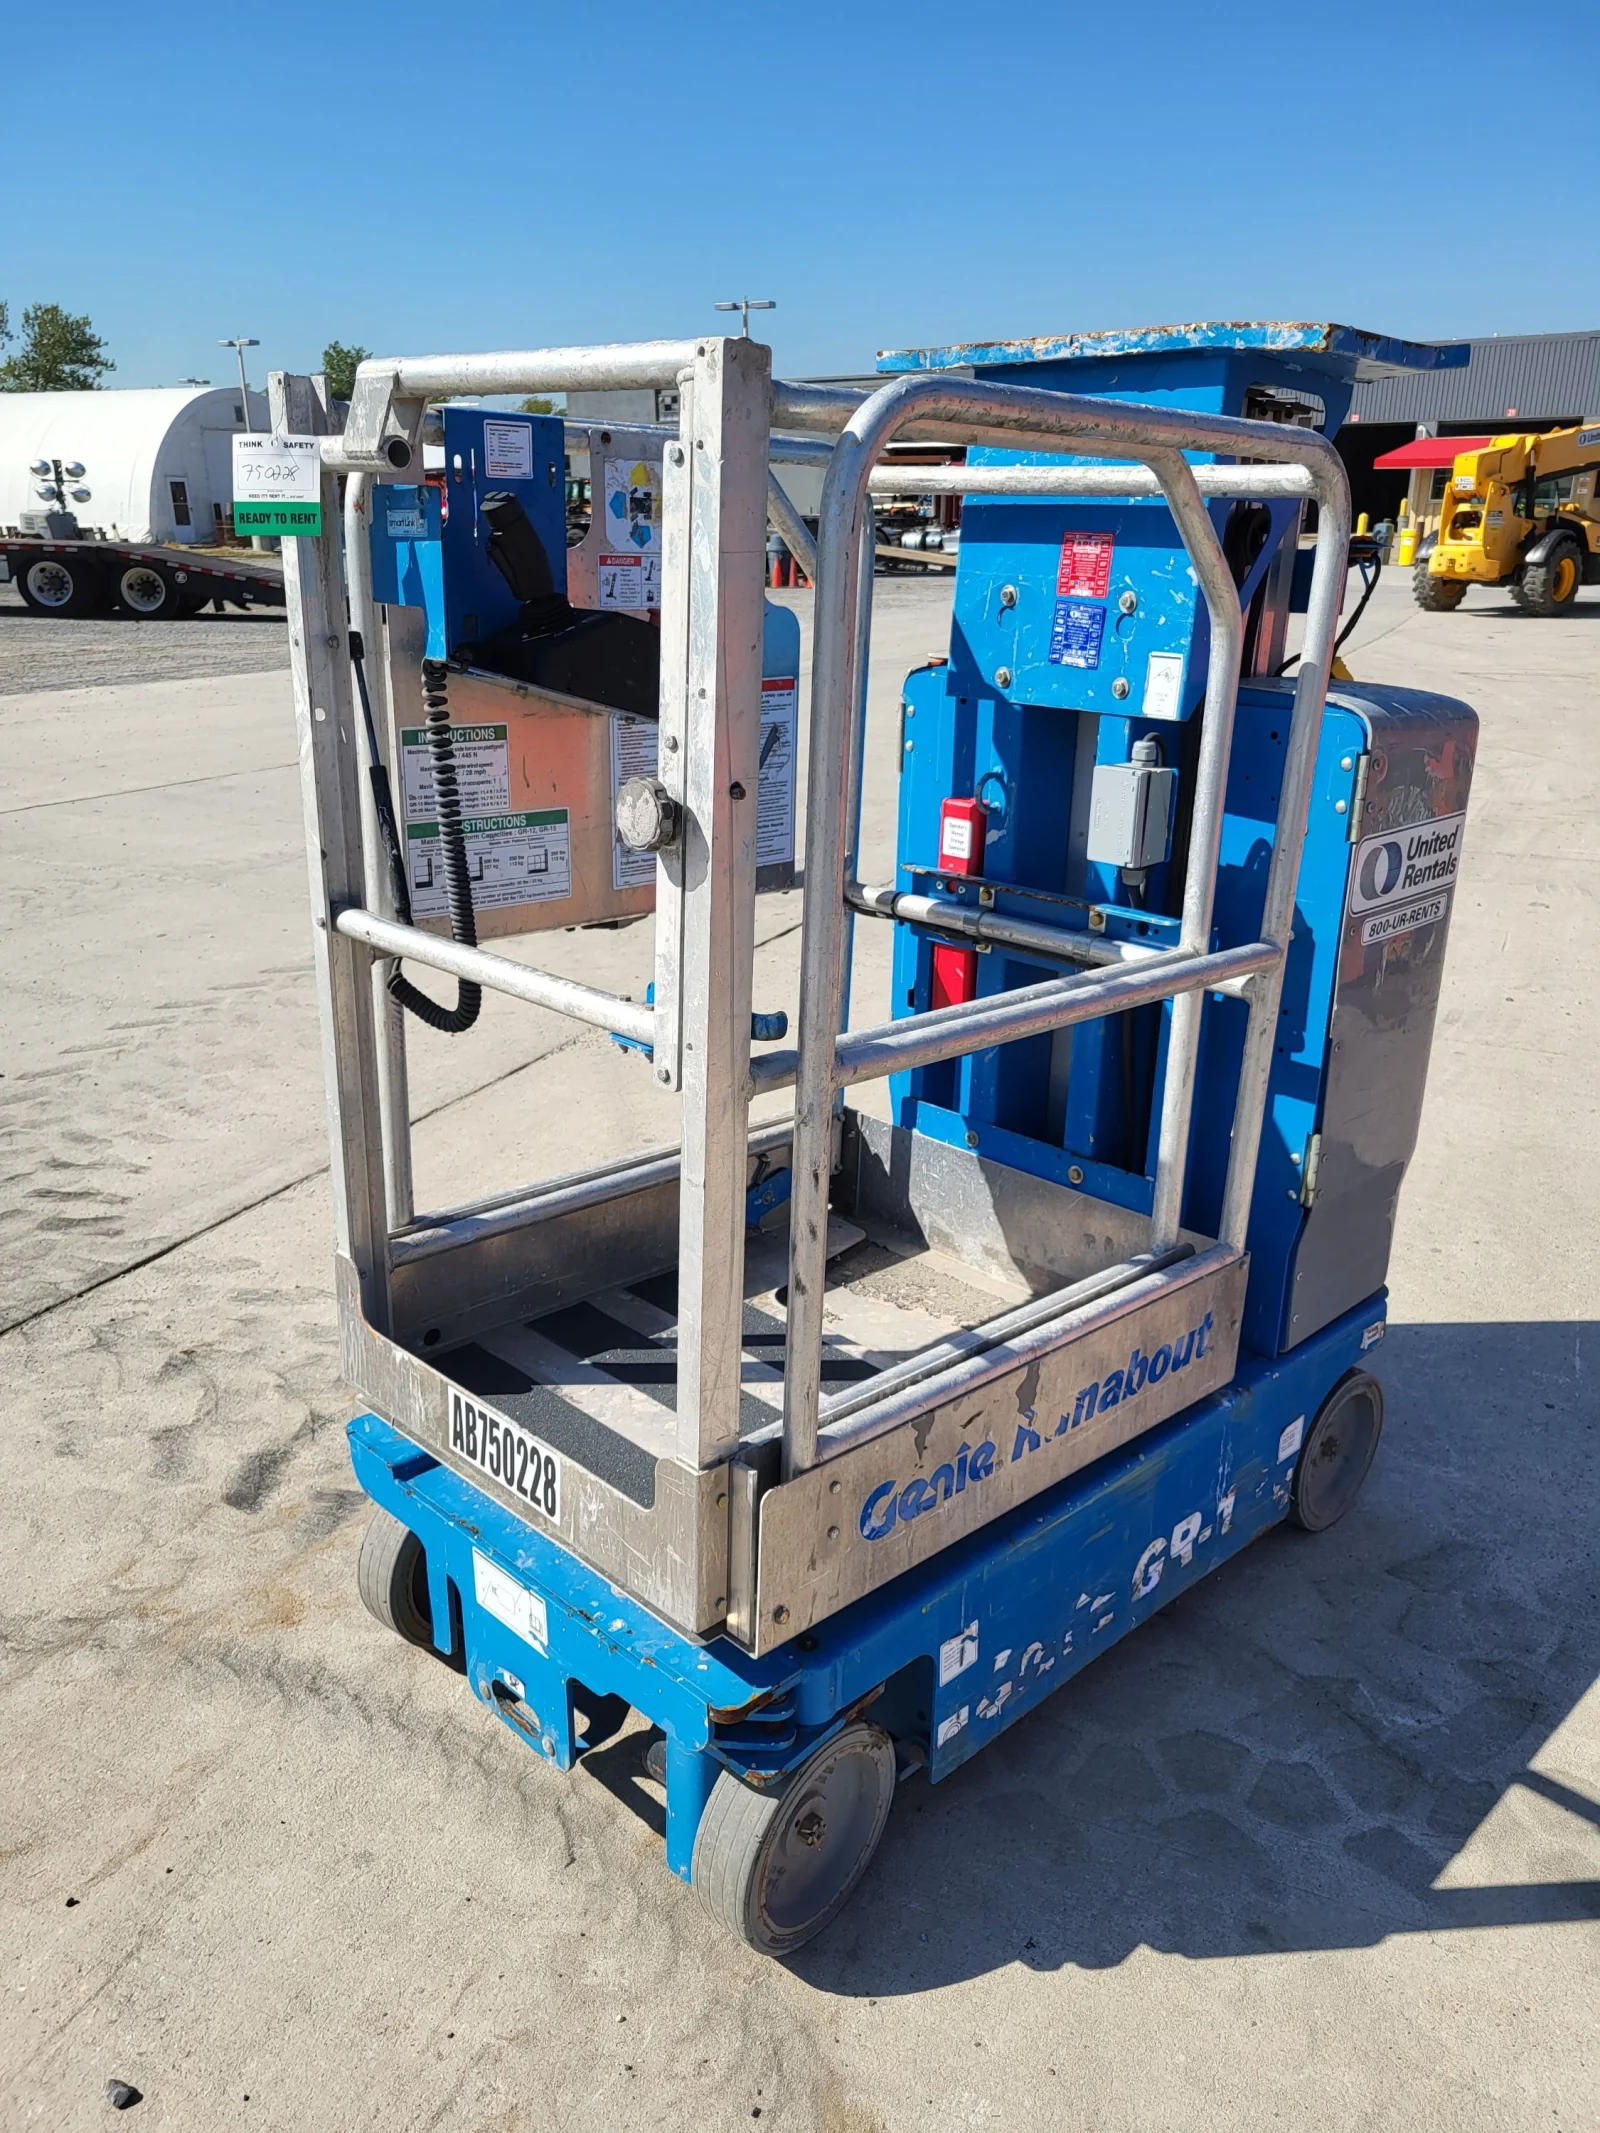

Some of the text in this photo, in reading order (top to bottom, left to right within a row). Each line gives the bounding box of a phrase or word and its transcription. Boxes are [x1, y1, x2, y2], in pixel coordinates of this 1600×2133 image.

[238, 440, 315, 449] THINK SAFETY
[242, 463, 300, 482] 750228
[239, 512, 317, 525] READY TO RENT
[418, 728, 495, 744] INUCTIONS
[461, 751, 472, 759] 445
[474, 768, 487, 777] mph
[462, 815, 527, 832] STRUCTIONS
[420, 837, 442, 846] Maxim
[481, 830, 513, 840] Capacities
[538, 825, 557, 833] GR-15
[1406, 824, 1460, 861] United
[1401, 852, 1458, 890] Rentals
[1368, 900, 1441, 938] 800-UR-RENTS
[452, 1393, 557, 1518] AB750228
[859, 1441, 997, 1541] Genie
